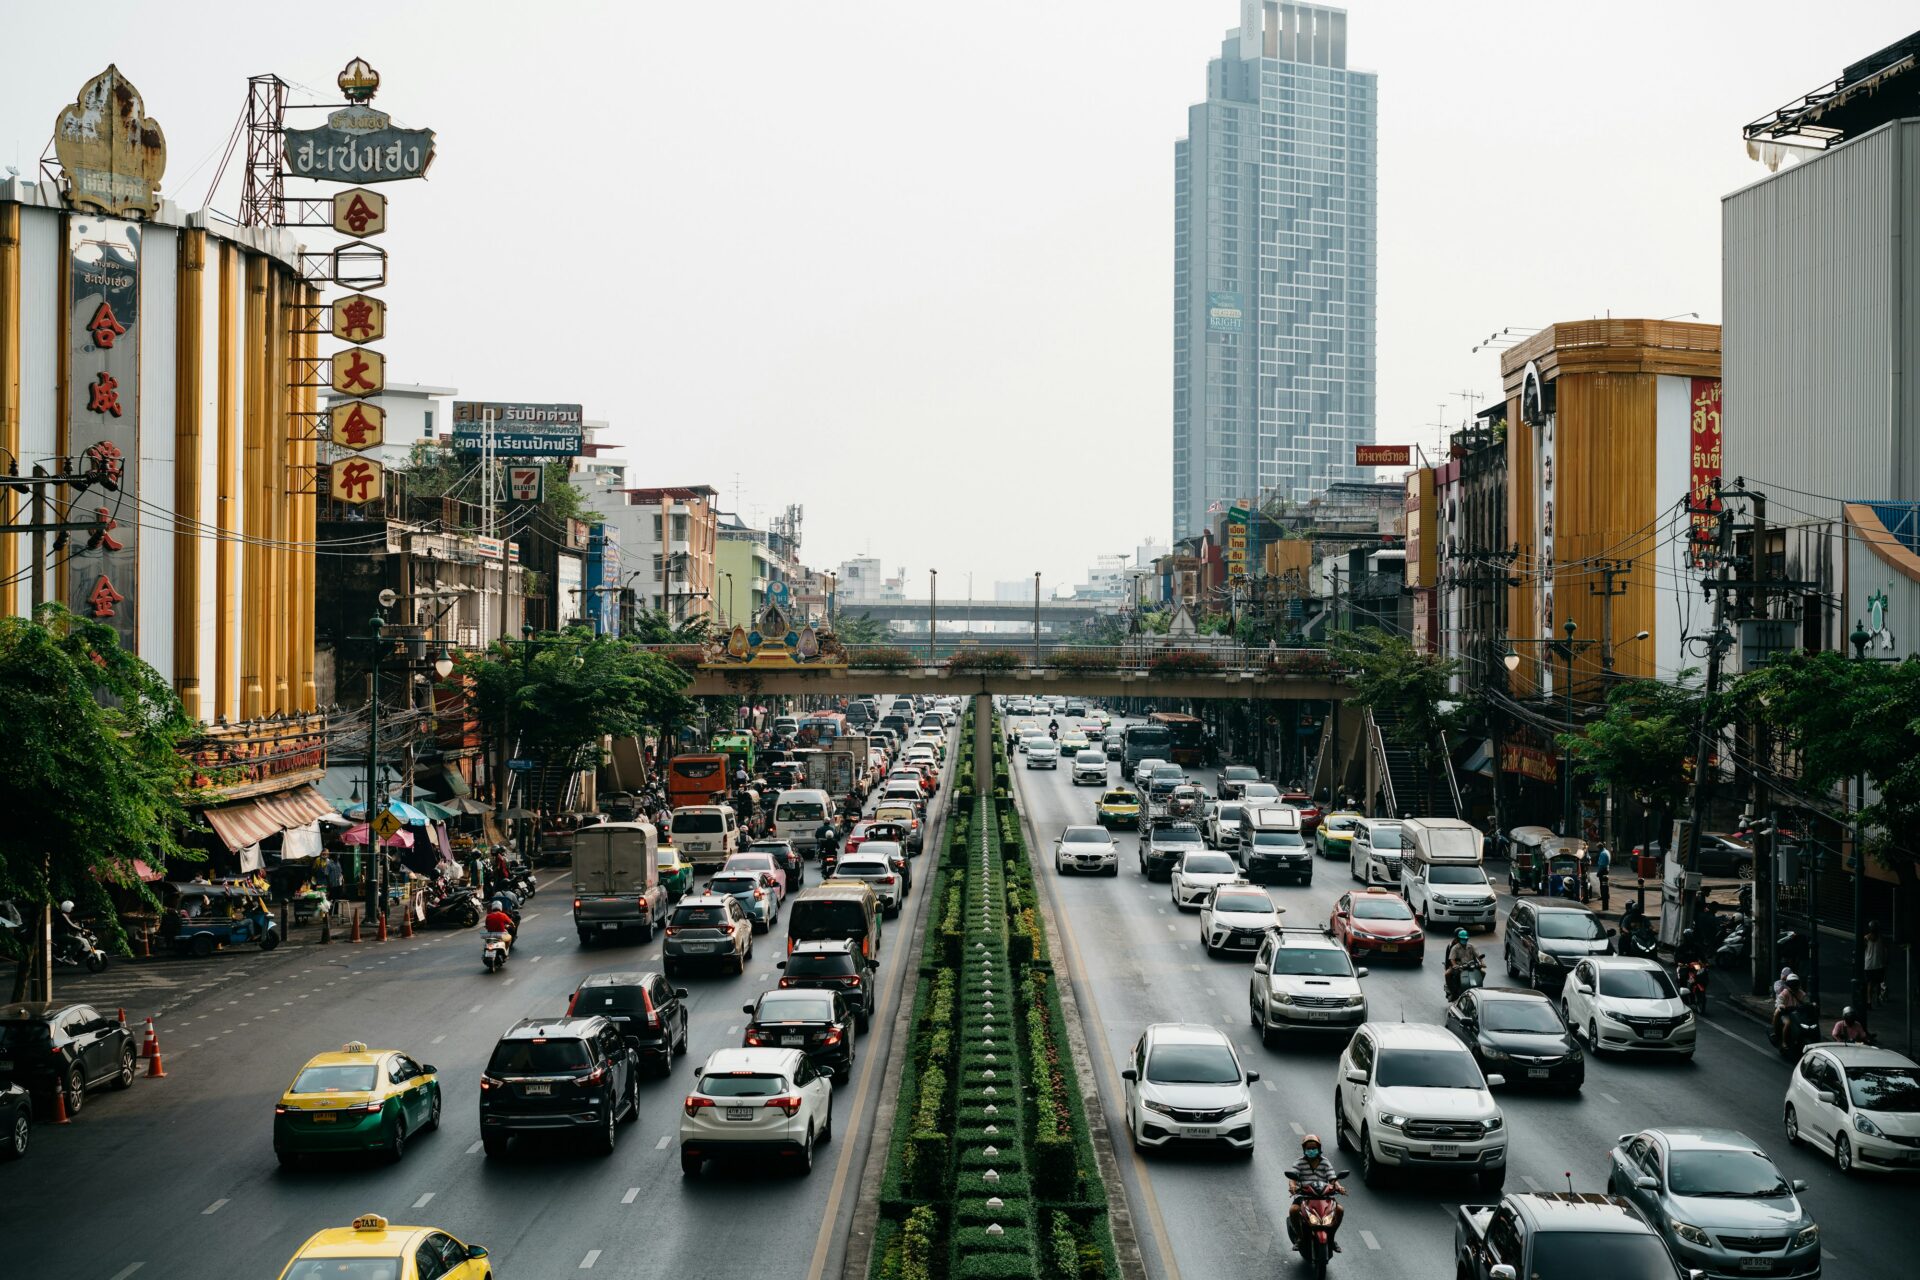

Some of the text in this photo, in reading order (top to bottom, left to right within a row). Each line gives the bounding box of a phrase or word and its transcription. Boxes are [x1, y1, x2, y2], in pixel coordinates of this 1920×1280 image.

[297, 134, 420, 173] ฮะเซ่งเฮง
[1210, 317, 1241, 328] BRIGHT
[506, 406, 579, 422] รับปักด่วน
[361, 1219, 378, 1228] TAXI
